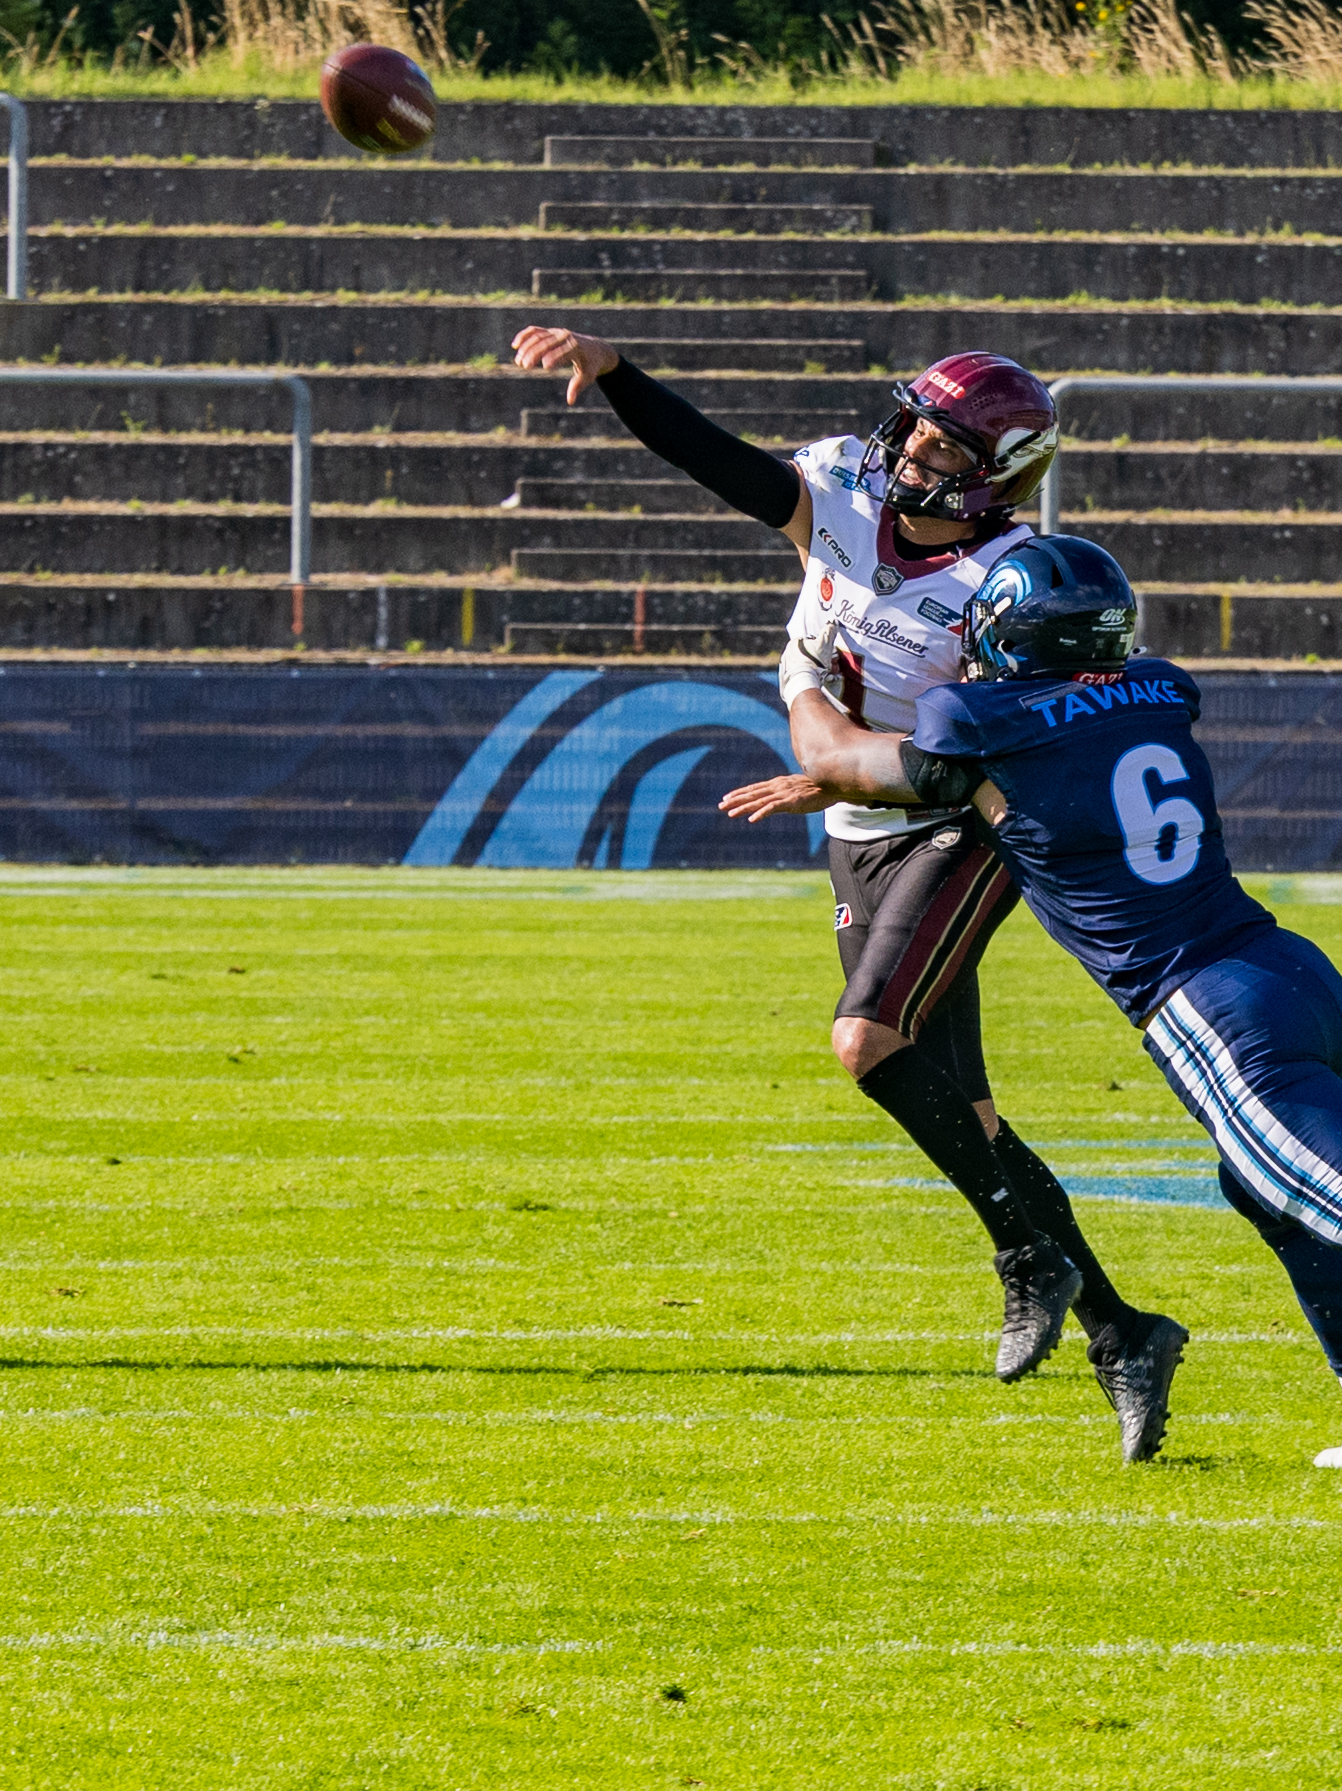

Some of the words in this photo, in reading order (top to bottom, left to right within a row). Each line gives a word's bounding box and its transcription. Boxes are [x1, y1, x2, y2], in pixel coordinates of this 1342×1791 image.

[929, 371, 963, 397] GAZI
[1031, 680, 1185, 727] TAWAKE
[1111, 743, 1204, 885] 6
